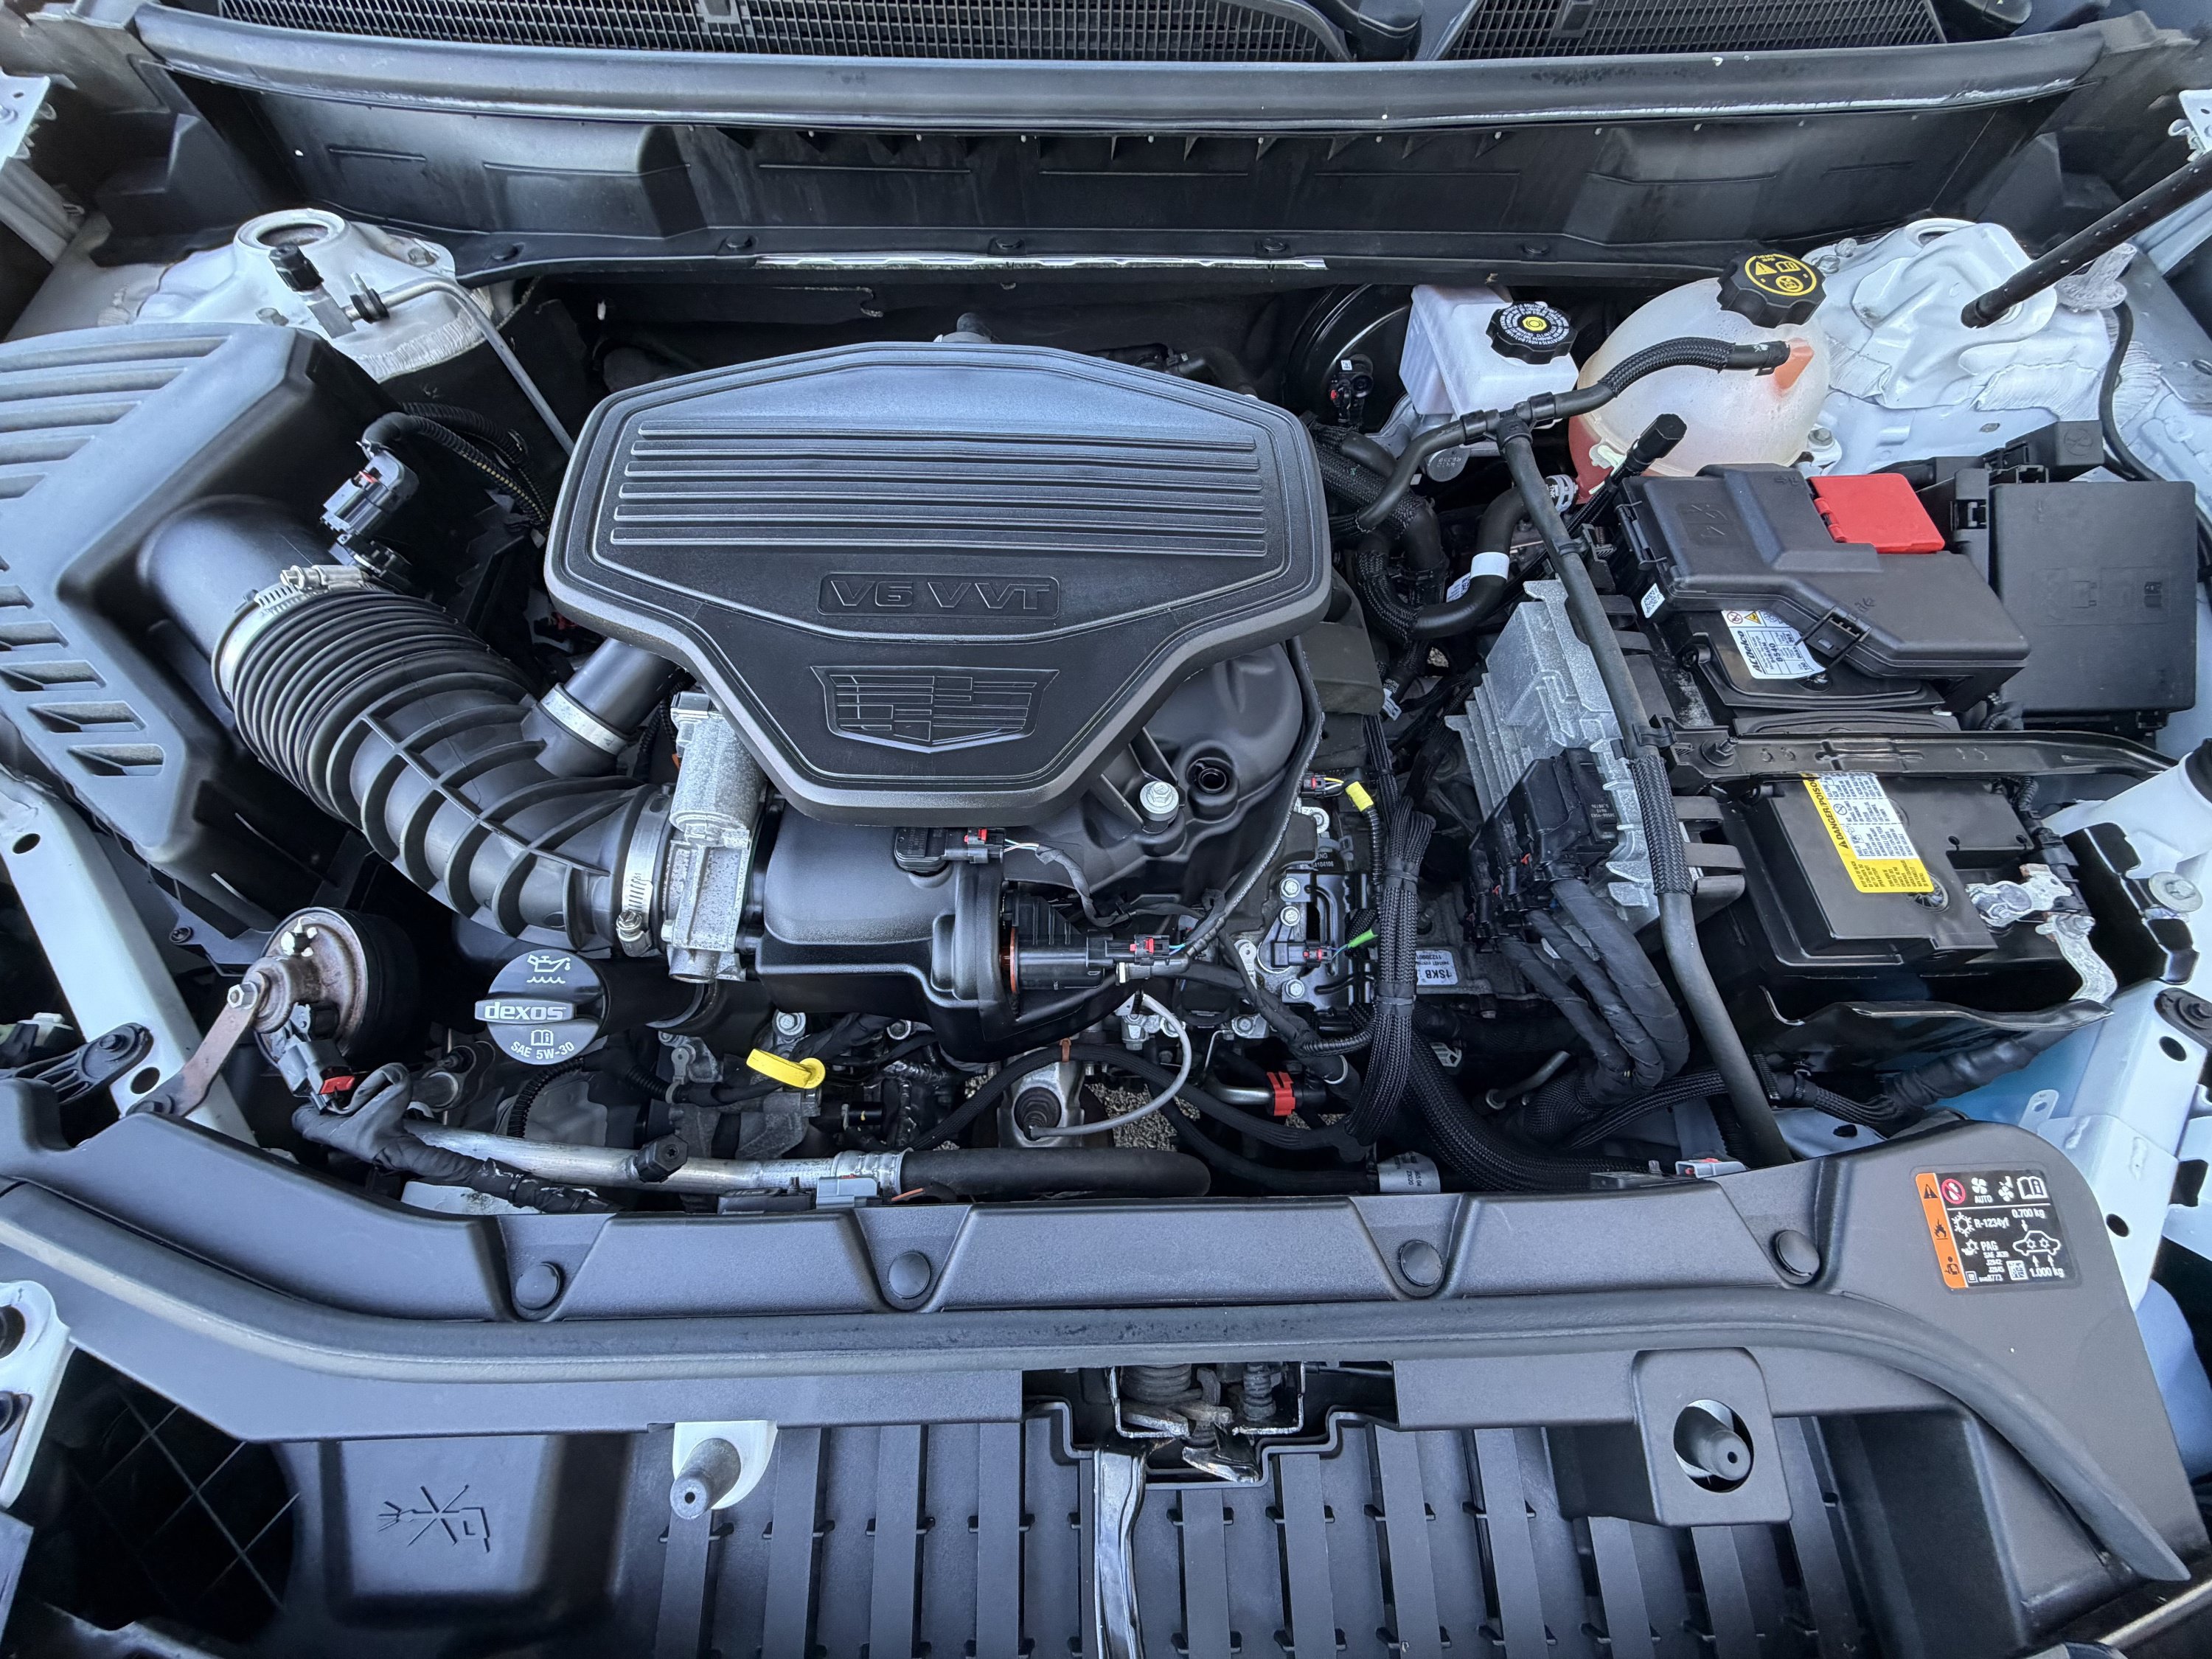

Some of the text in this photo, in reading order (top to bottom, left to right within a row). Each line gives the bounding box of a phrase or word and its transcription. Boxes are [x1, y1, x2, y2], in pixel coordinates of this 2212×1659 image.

[830, 580, 1051, 611] V6 VVT
[1737, 630, 1761, 672] ACDelco
[1233, 877, 1256, 907] COOPER
[1425, 970, 1452, 979] 1SKB
[484, 1002, 565, 1020] dexos
[510, 1041, 575, 1060] SAE 5W-30
[1975, 1195, 1993, 1203] AUTO
[2011, 1208, 2046, 1219] 0.700 kg
[1975, 1217, 2010, 1228] R-1234yf
[1980, 1241, 1999, 1251] PAG
[2029, 1266, 2065, 1279] 1.000 kg
